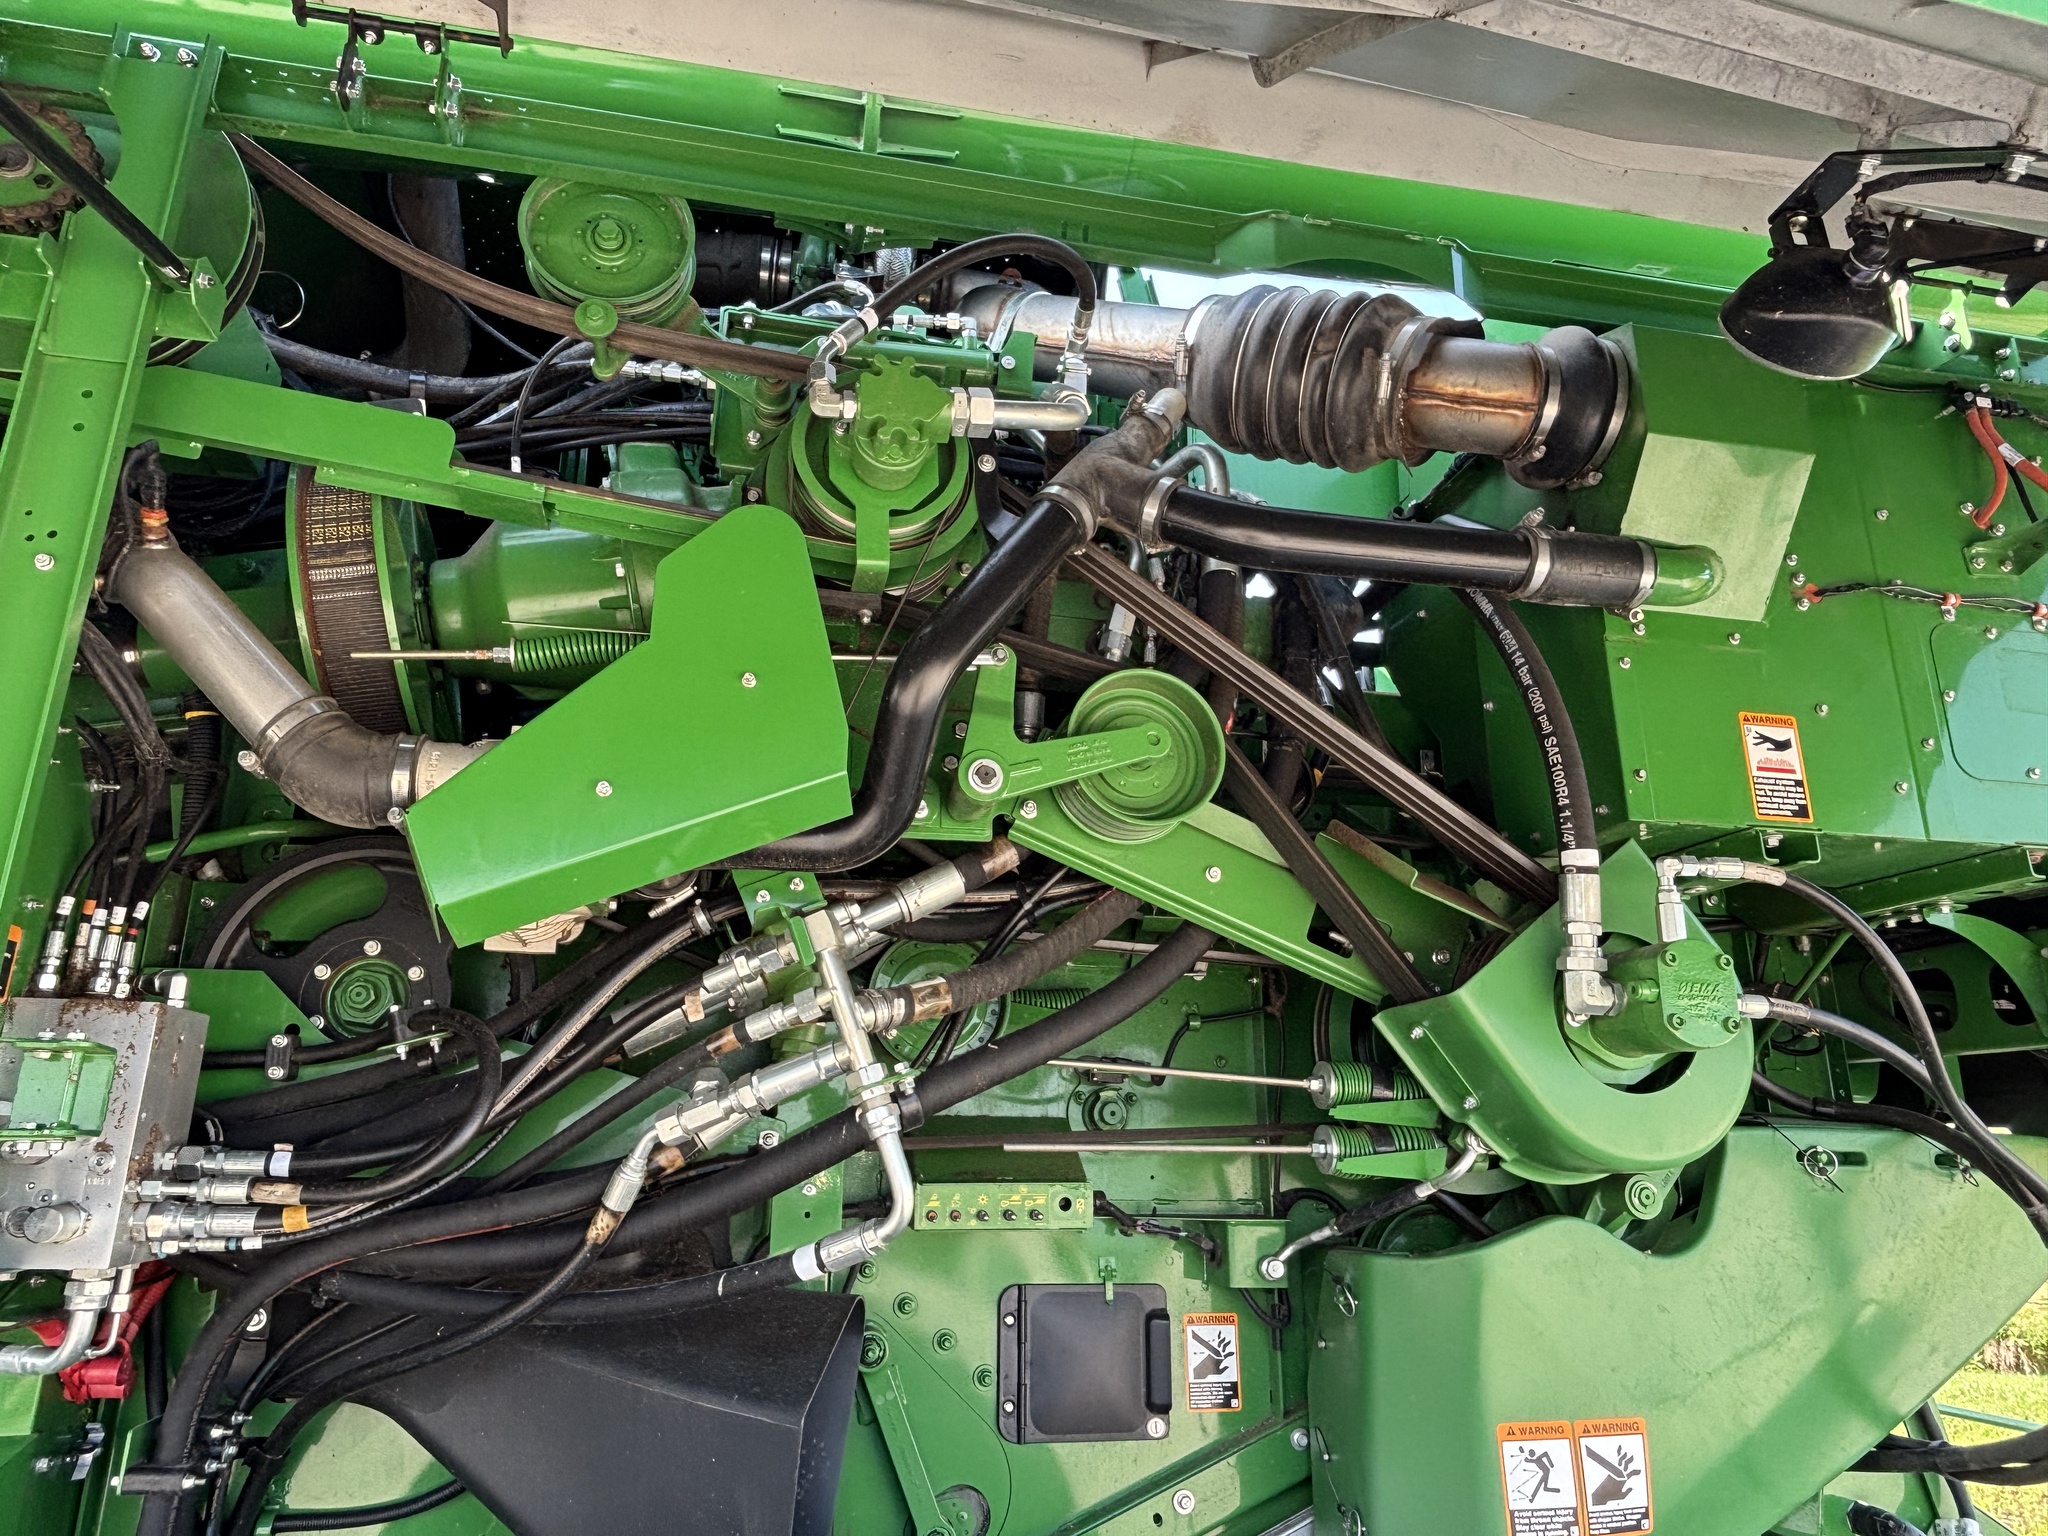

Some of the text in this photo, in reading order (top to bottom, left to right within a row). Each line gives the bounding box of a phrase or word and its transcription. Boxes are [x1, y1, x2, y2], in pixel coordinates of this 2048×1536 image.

[1490, 612, 1504, 631] ITALY
[1511, 651, 1526, 667] 14
[1517, 665, 1533, 686] bar
[1527, 686, 1546, 714] (200
[1537, 714, 1554, 735] psi)
[1750, 715, 1794, 726] WARNING
[1544, 736, 1570, 806] SAE100R4
[1195, 1315, 1235, 1324] WARNING
[1518, 1425, 1565, 1436] WARNING
[1591, 1421, 1640, 1434] WARNING
